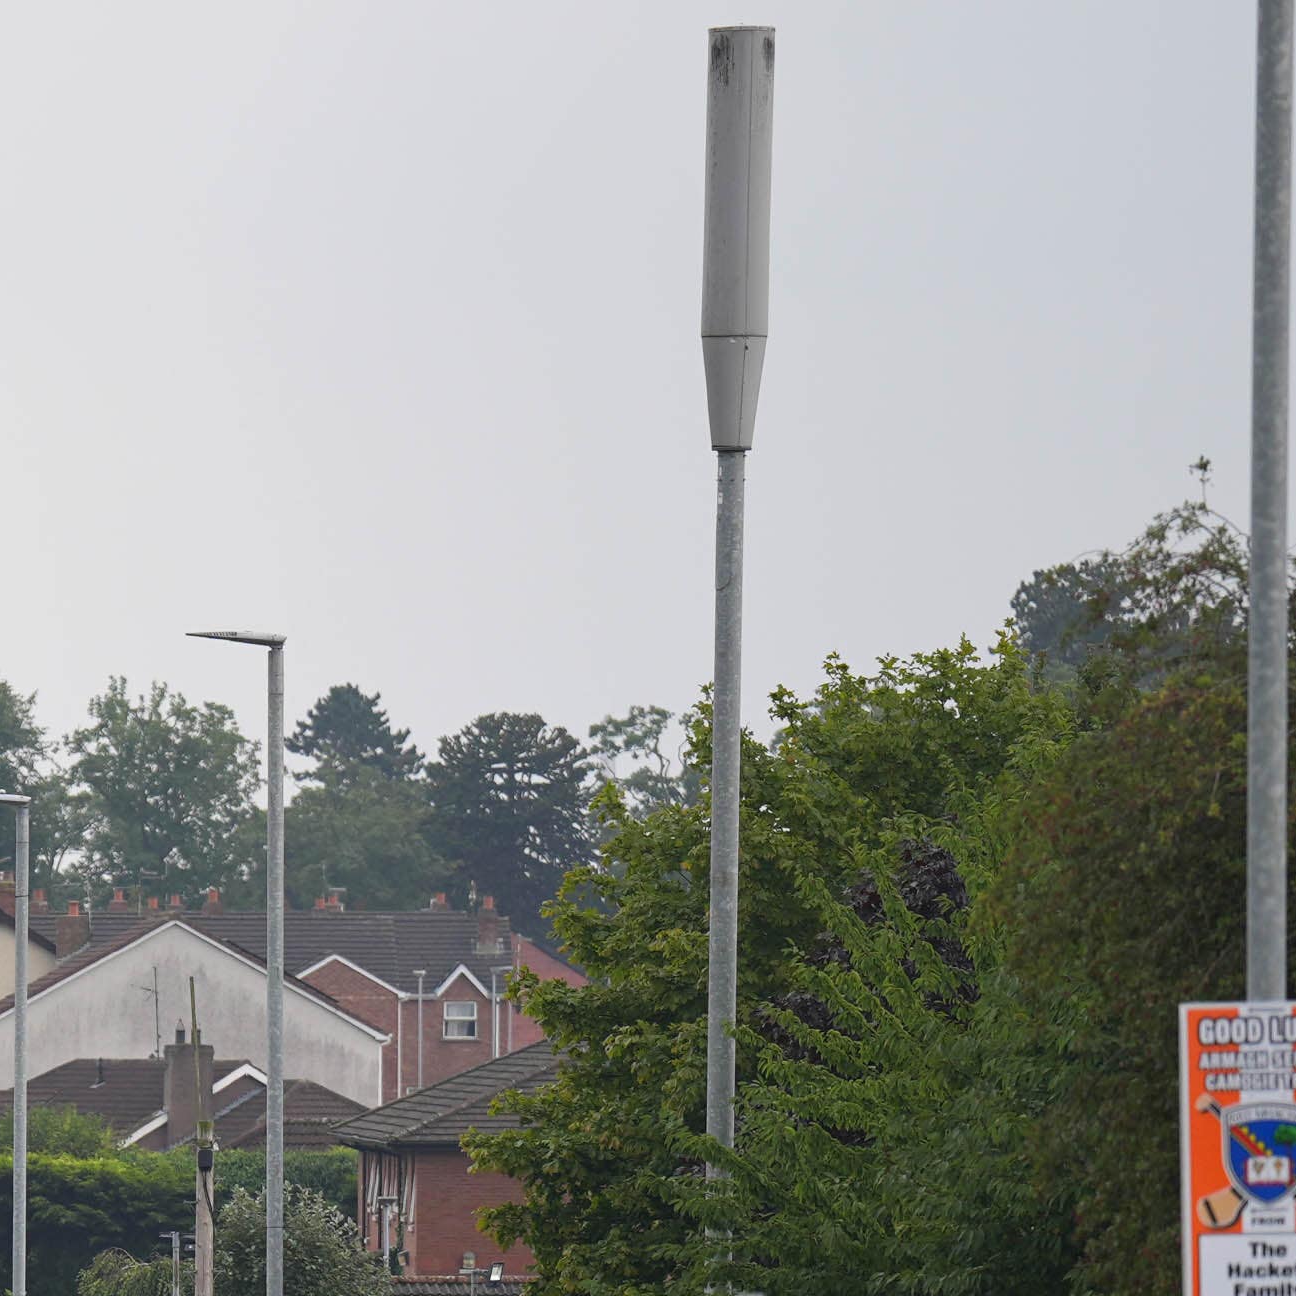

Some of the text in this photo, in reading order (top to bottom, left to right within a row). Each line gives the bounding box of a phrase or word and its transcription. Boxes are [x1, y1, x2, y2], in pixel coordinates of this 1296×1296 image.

[1198, 1016, 1264, 1046] GOOD
[1248, 1241, 1287, 1258] The
[1228, 1262, 1296, 1279] Hacke
